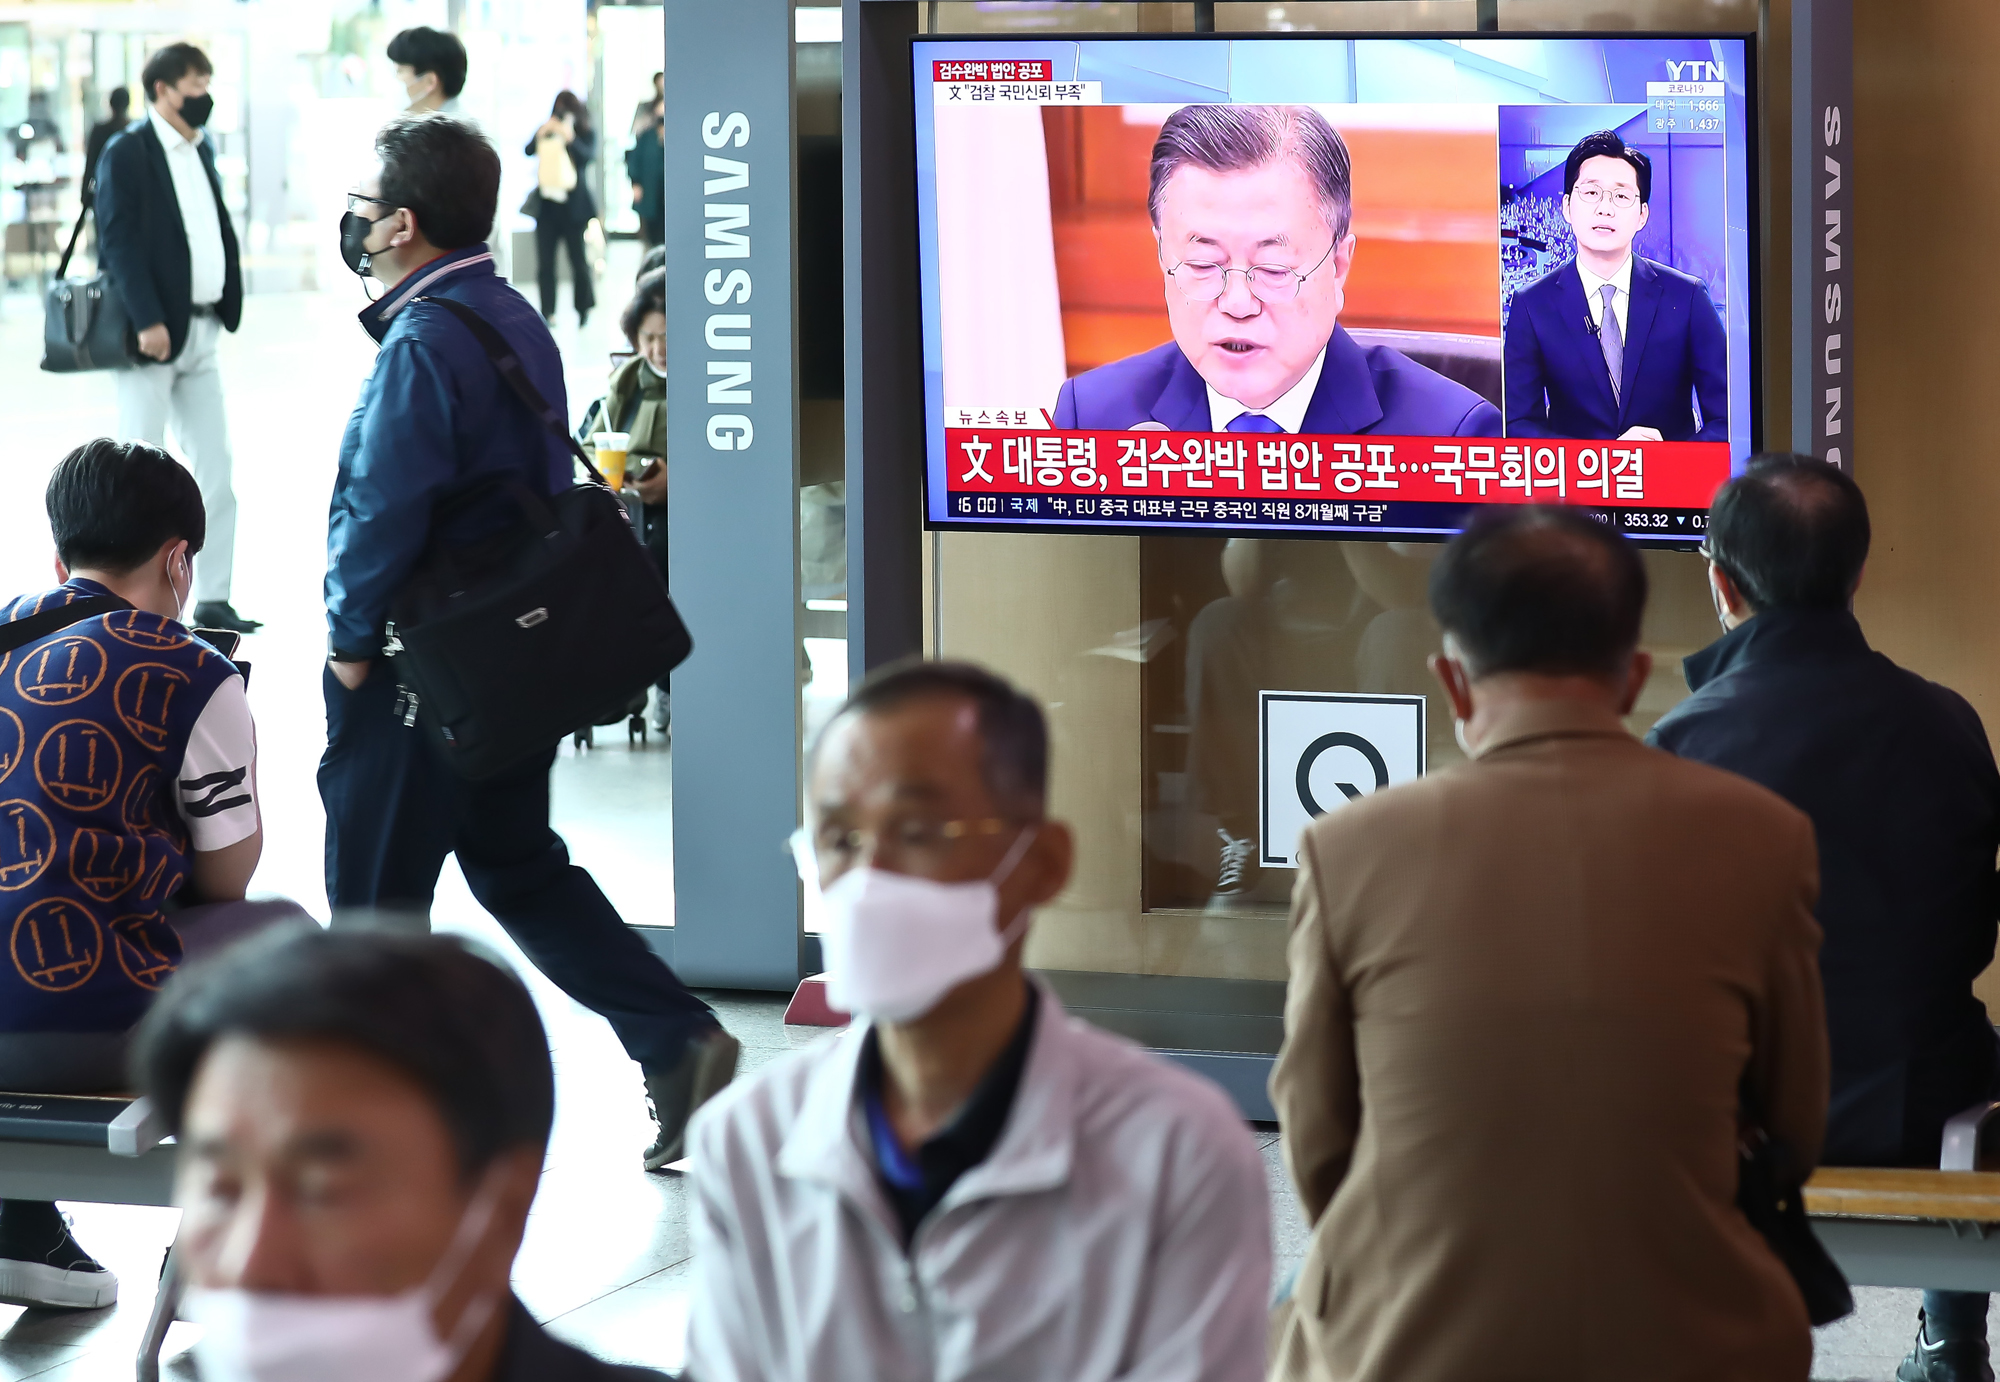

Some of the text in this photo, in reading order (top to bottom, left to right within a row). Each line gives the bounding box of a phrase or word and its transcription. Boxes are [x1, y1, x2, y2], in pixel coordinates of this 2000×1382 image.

[939, 62, 1044, 80] 검수완박 법안 공포
[1666, 59, 1725, 81] YTN
[949, 84, 1086, 101] 文 "검찰 국민신뢰 부족"
[1668, 84, 1704, 94] 코로나19
[1688, 100, 1719, 112] 1,666
[1688, 118, 1720, 131] 1,437
[701, 111, 754, 452] SAMSUNG
[960, 434, 994, 484] 文
[1002, 435, 1108, 492] 대통령,
[1116, 437, 1248, 491] 검수완박
[1256, 440, 1323, 491] 법안
[1576, 447, 1645, 500] 의결
[1075, 498, 1096, 515] EU
[1099, 498, 1129, 517] 중국
[1133, 499, 1176, 517] 대표부
[1180, 500, 1210, 518] 근무
[1213, 501, 1257, 519] 중국인
[1261, 501, 1291, 520] 직원
[1294, 502, 1349, 521] 8개월째
[1352, 503, 1388, 522] 구금"
[1624, 512, 1669, 528] 353.32
